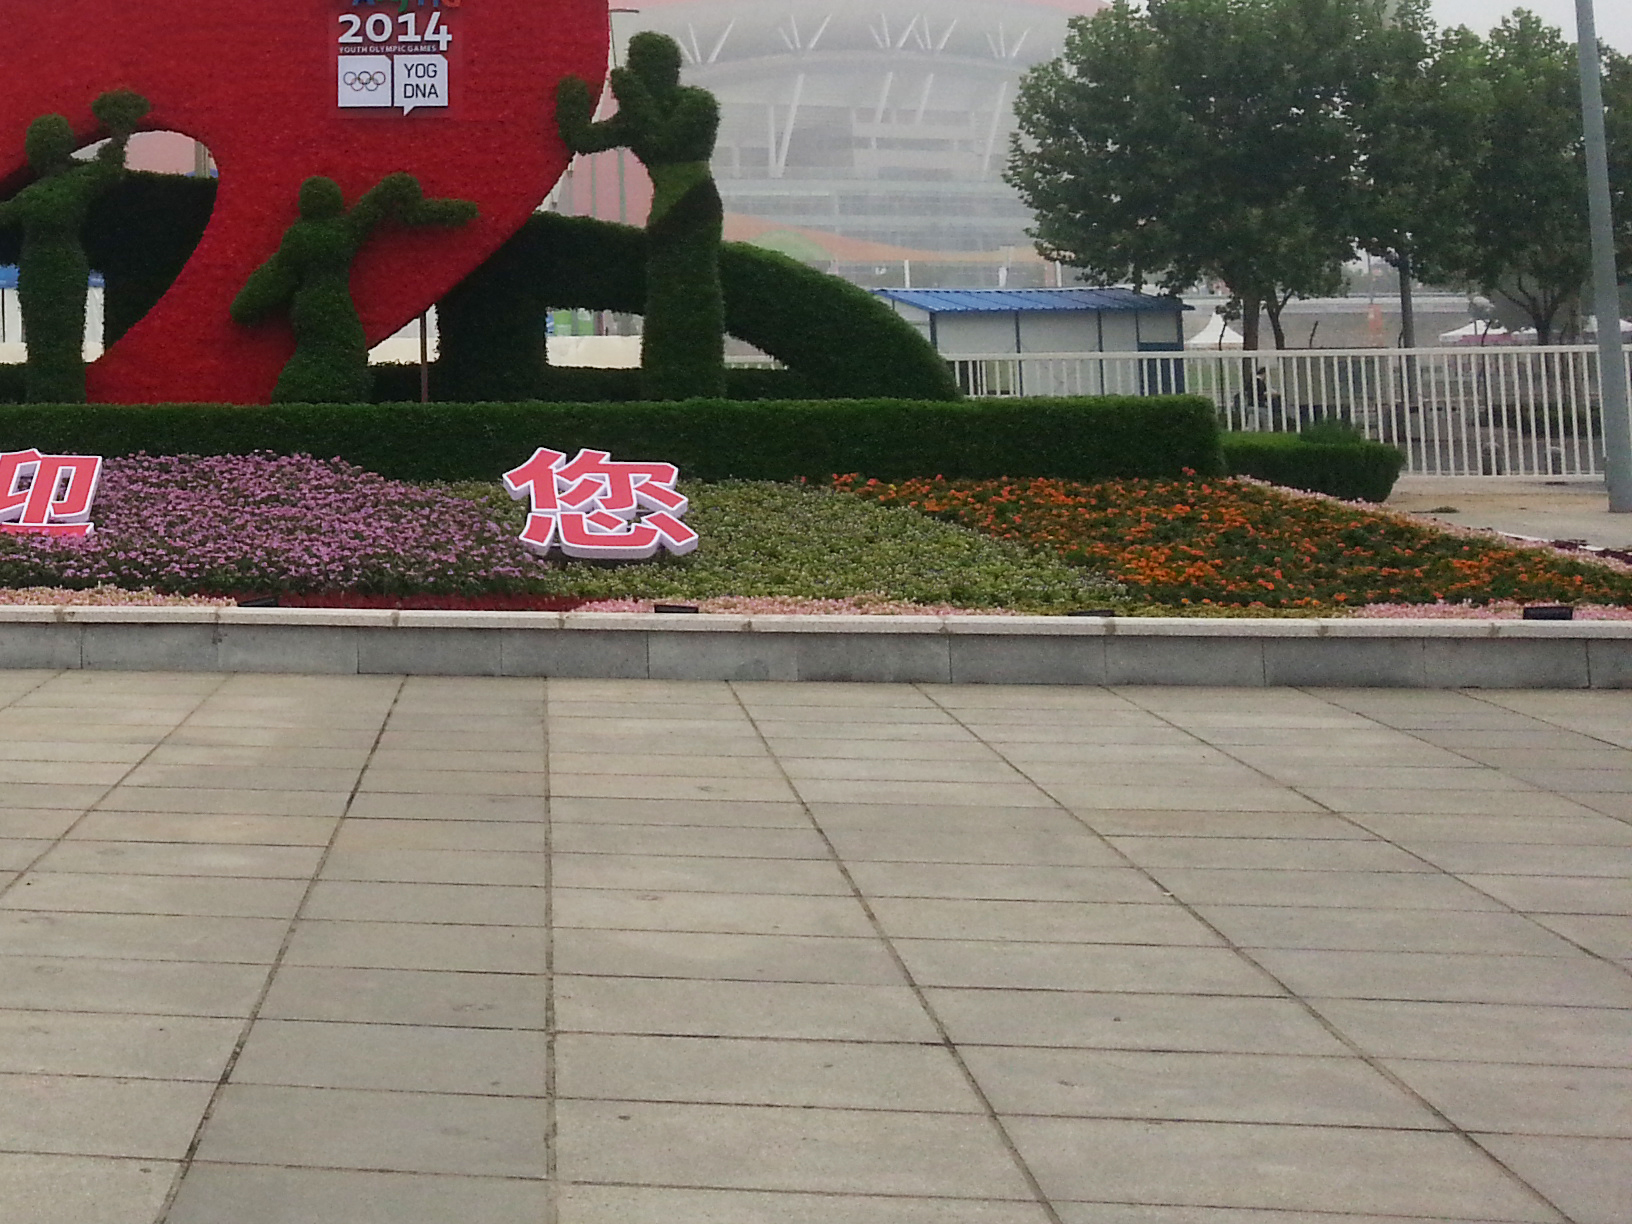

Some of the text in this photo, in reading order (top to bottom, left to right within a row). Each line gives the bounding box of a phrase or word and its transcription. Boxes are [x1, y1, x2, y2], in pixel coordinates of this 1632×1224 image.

[338, 11, 452, 51] 2014
[369, 45, 406, 53] OLYMPIC
[404, 63, 437, 78] YOG
[404, 84, 438, 98] DNA
[502, 447, 699, 559] 您
